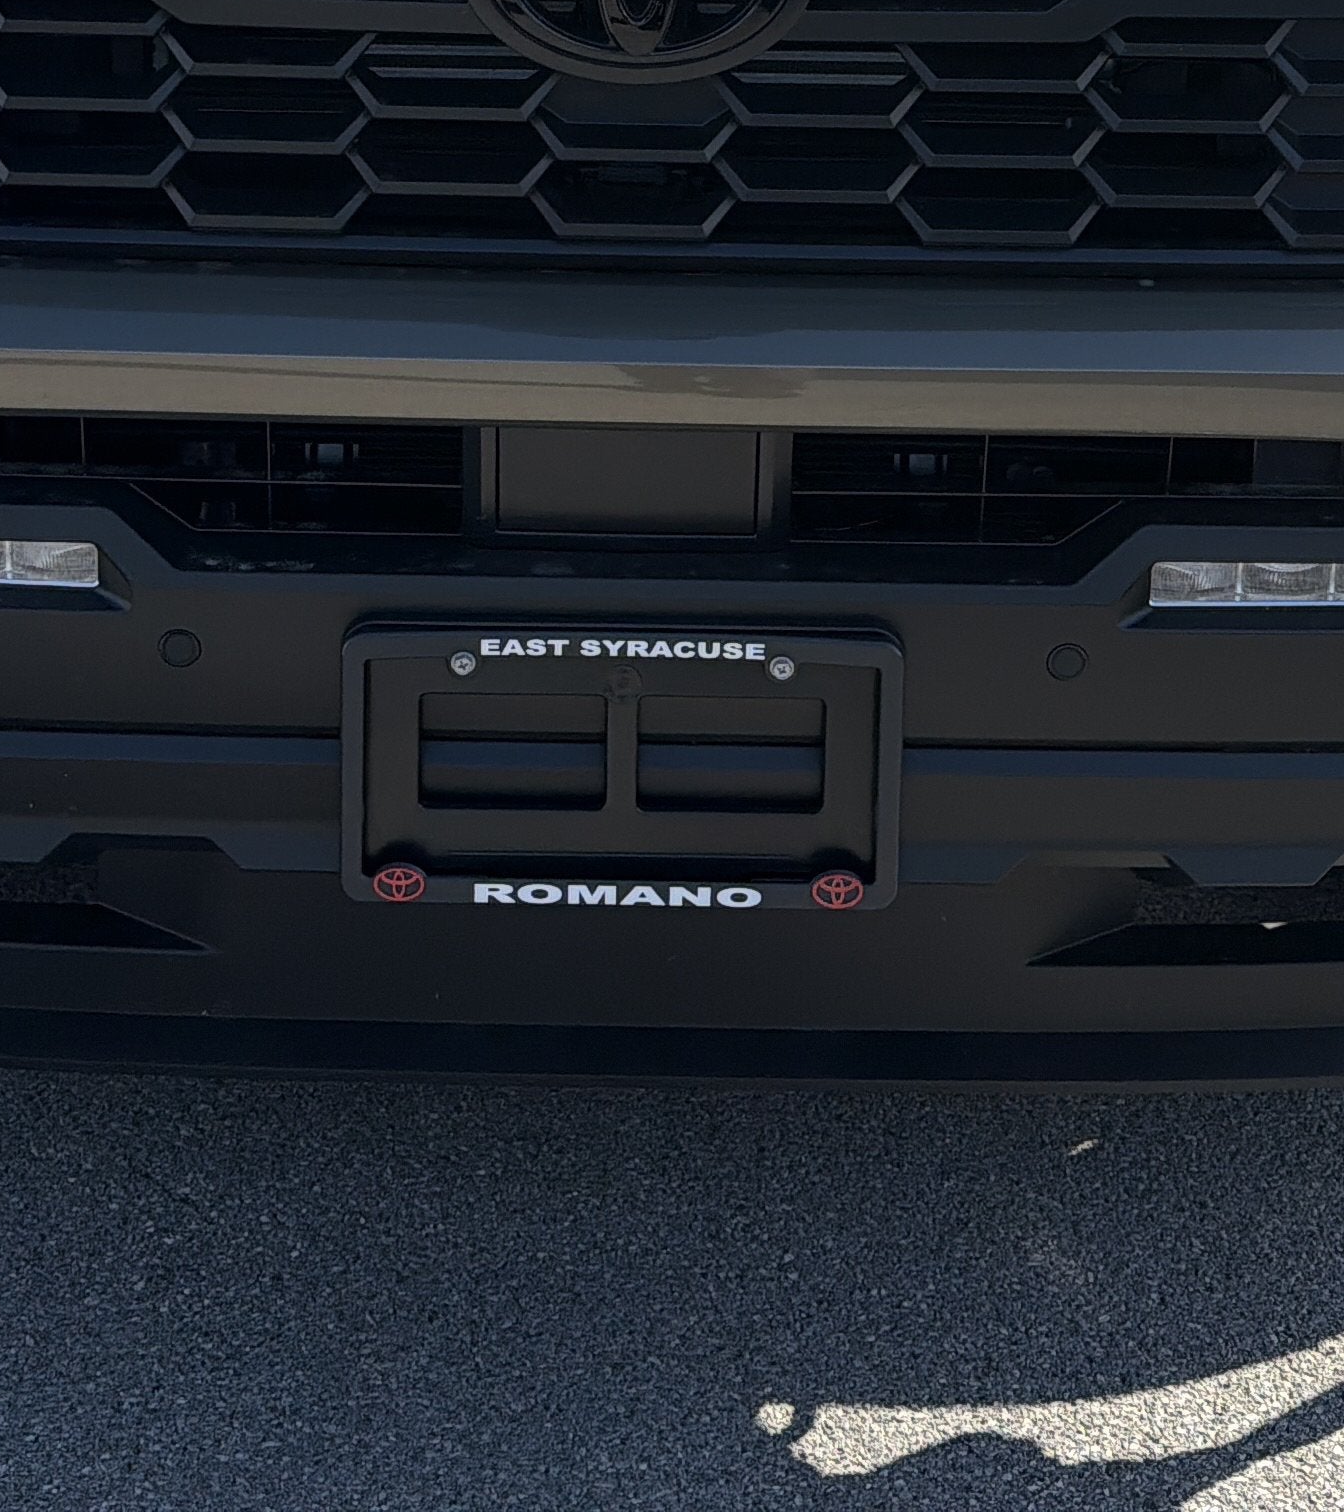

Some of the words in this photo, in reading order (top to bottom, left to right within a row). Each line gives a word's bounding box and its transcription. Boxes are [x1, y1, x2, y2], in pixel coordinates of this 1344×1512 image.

[480, 639, 570, 657] EAST
[579, 639, 766, 660] SYRACUSE
[473, 883, 762, 908] ROMANO
